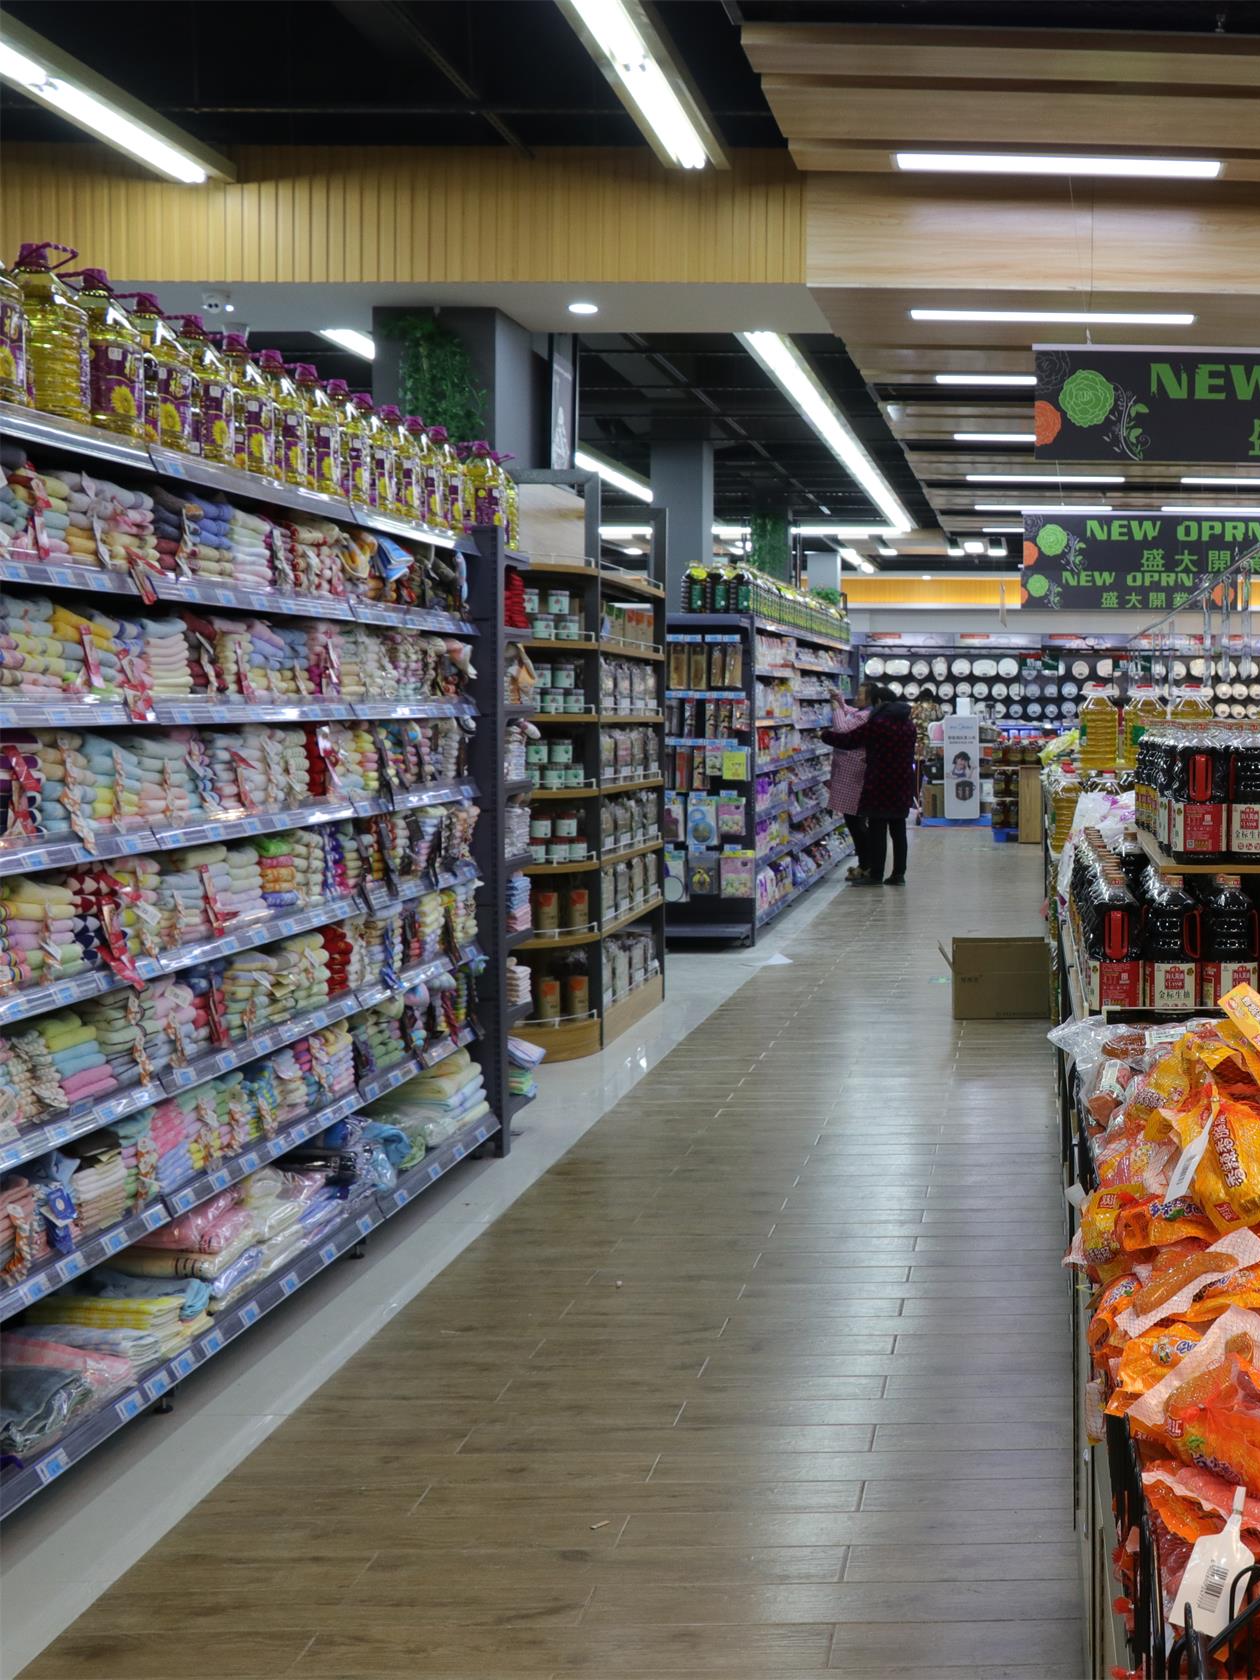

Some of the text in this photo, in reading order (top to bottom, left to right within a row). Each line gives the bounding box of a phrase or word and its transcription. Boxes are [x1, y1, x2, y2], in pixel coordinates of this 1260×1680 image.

[1086, 519, 1161, 541] NEW
[1061, 571, 1194, 587] NEW OPRN
[1158, 990, 1191, 1001] 金标生抽
